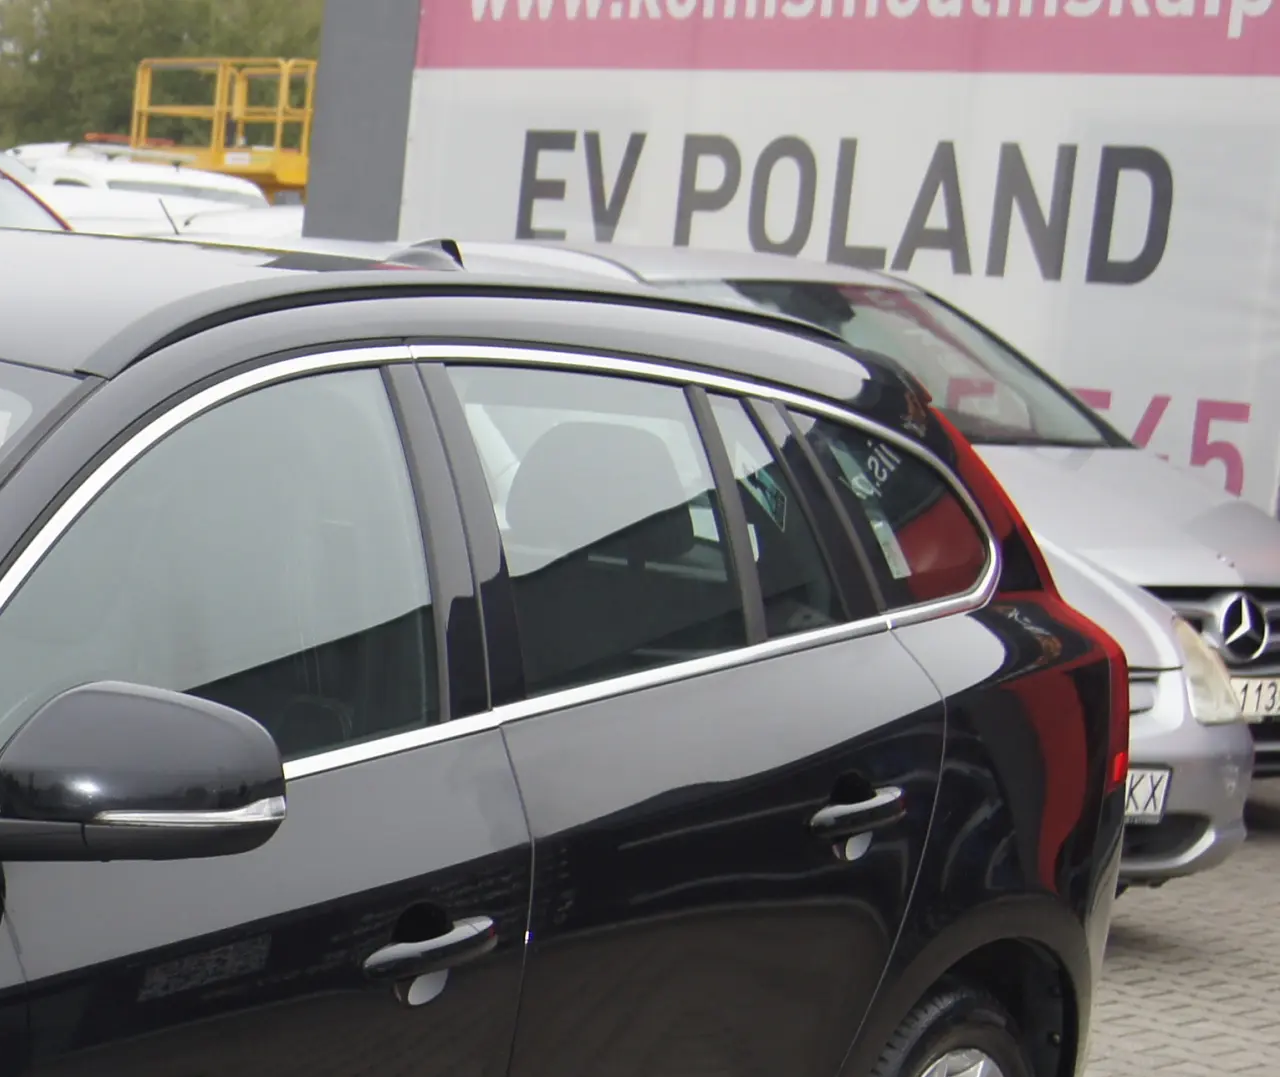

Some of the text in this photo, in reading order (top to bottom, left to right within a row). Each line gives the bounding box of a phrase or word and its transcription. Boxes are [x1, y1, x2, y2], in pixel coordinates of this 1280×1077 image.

[514, 129, 1174, 286] EV POLAND
[1240, 682, 1280, 713] 113
[1125, 773, 1165, 812] KX
